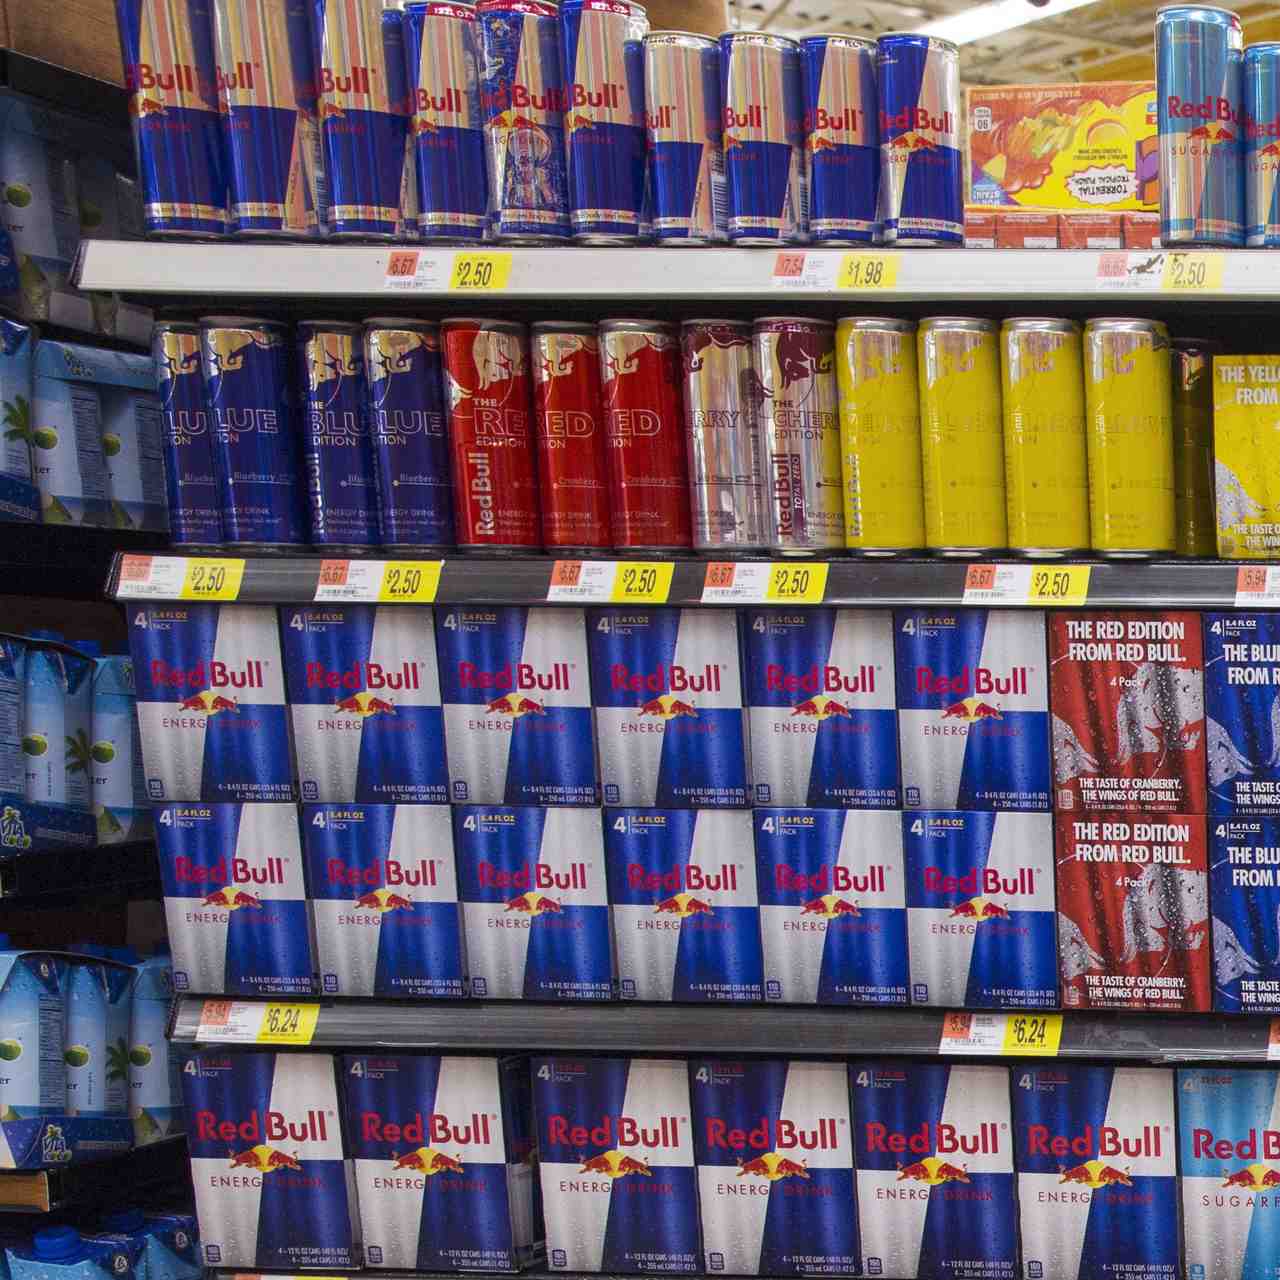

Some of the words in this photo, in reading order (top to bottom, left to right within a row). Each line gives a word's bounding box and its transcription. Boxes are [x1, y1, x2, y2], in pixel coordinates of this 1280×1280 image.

[455, 257, 493, 287] $2.50
[847, 256, 883, 285] $1.98
[1220, 366, 1244, 382] THE
[1236, 388, 1278, 404] FROM
[622, 568, 656, 594] $2.50
[1066, 622, 1092, 640] THE
[1096, 622, 1125, 640] RED
[1129, 622, 1184, 640] EDITION
[1069, 643, 1112, 660] FROM
[1116, 644, 1144, 661] RED
[1148, 644, 1186, 662] BULL.
[1223, 646, 1250, 662] THE
[1110, 677, 1117, 688] 4
[1228, 668, 1270, 685] FROM
[1078, 779, 1093, 789] THE
[1096, 779, 1118, 789] TASTE
[1120, 779, 1130, 789] OF
[1013, 1018, 1046, 1044] $6.24
[1194, 1129, 1256, 1160] Red
